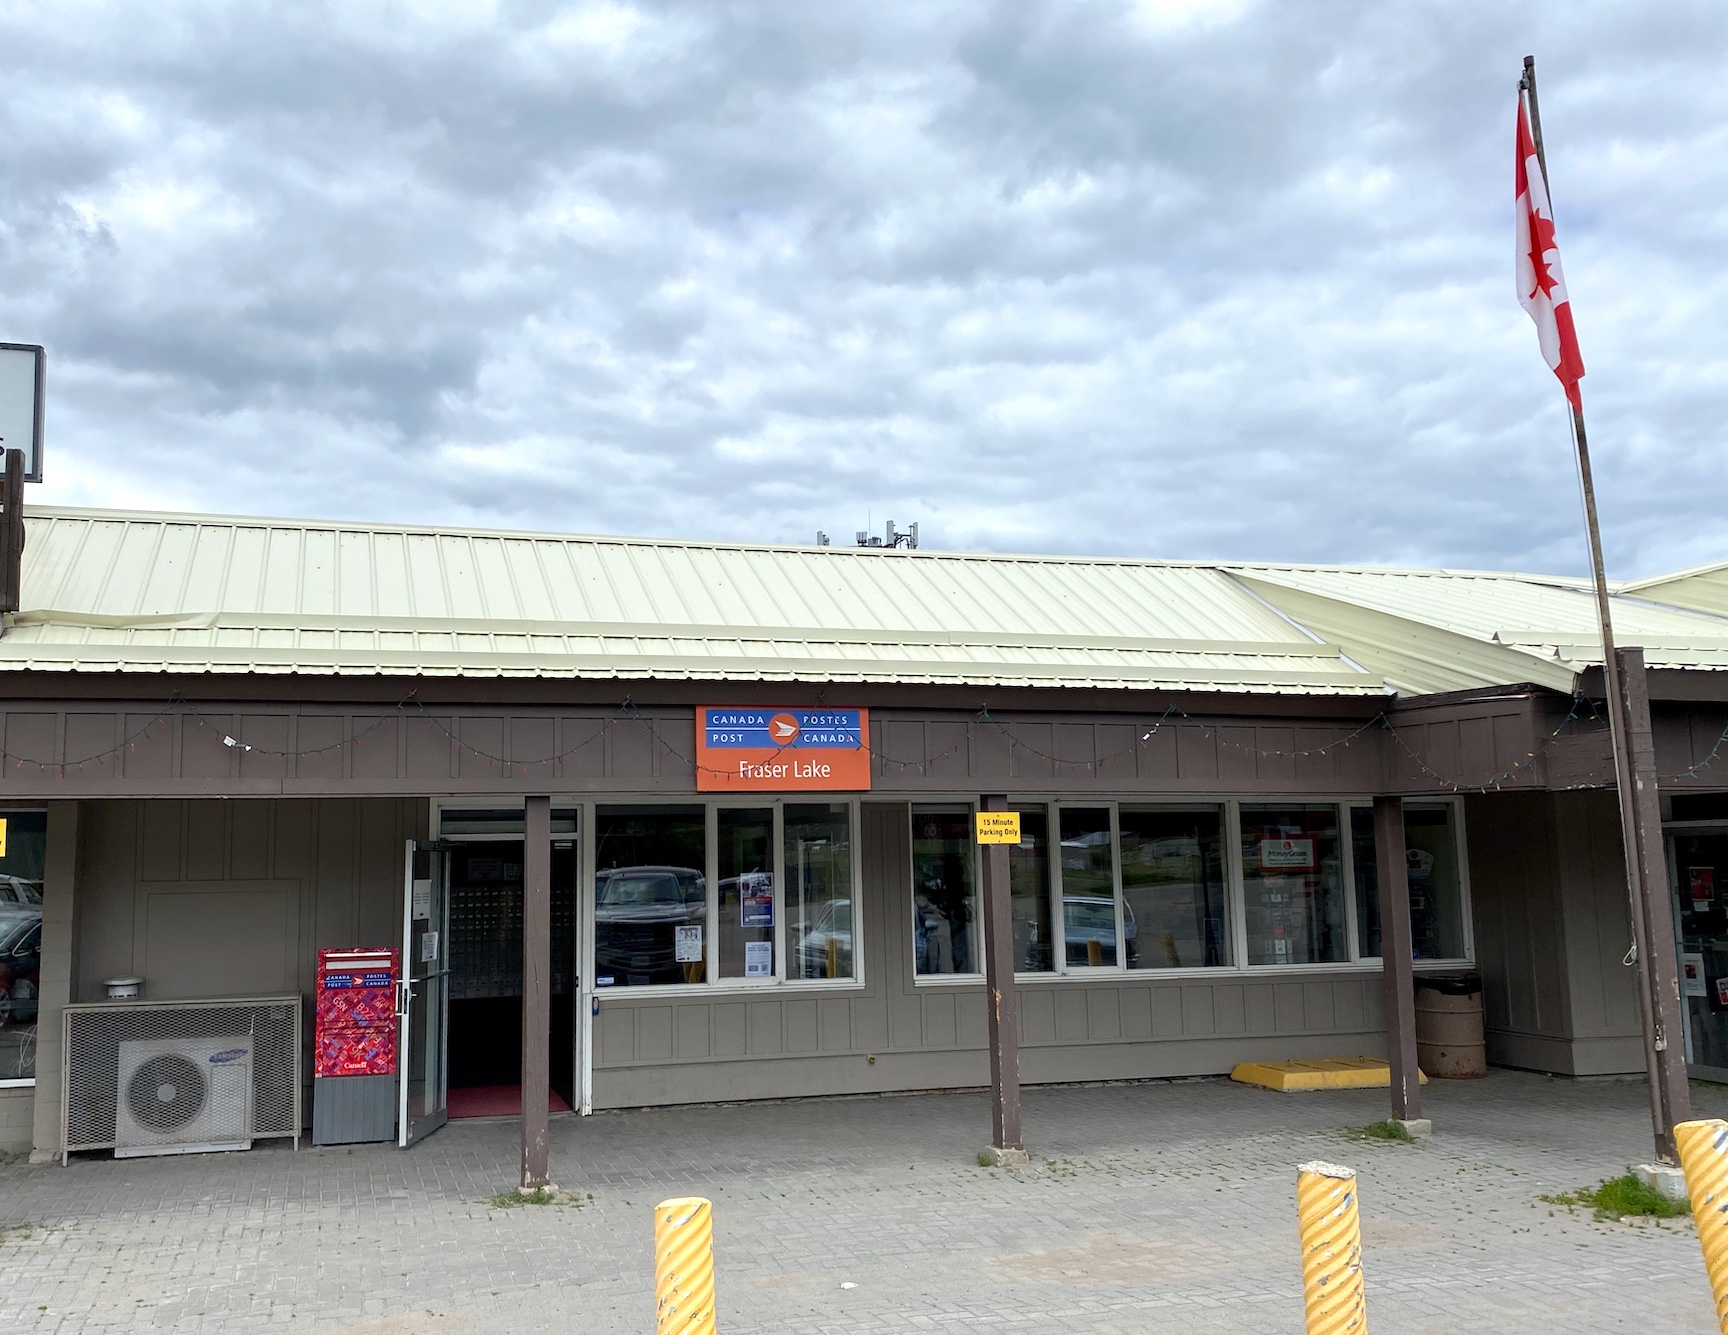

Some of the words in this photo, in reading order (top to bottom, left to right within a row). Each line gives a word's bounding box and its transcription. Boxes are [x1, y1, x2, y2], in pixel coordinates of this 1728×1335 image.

[712, 715, 765, 725] CANADA
[803, 715, 848, 725] POSTES
[712, 734, 744, 743] POST
[803, 734, 854, 743] CANADA
[739, 760, 789, 779] Fraser
[794, 759, 831, 779] Lake
[979, 828, 1003, 837] Parking
[1004, 828, 1018, 837] Only
[356, 1002, 375, 1020] B2Z
